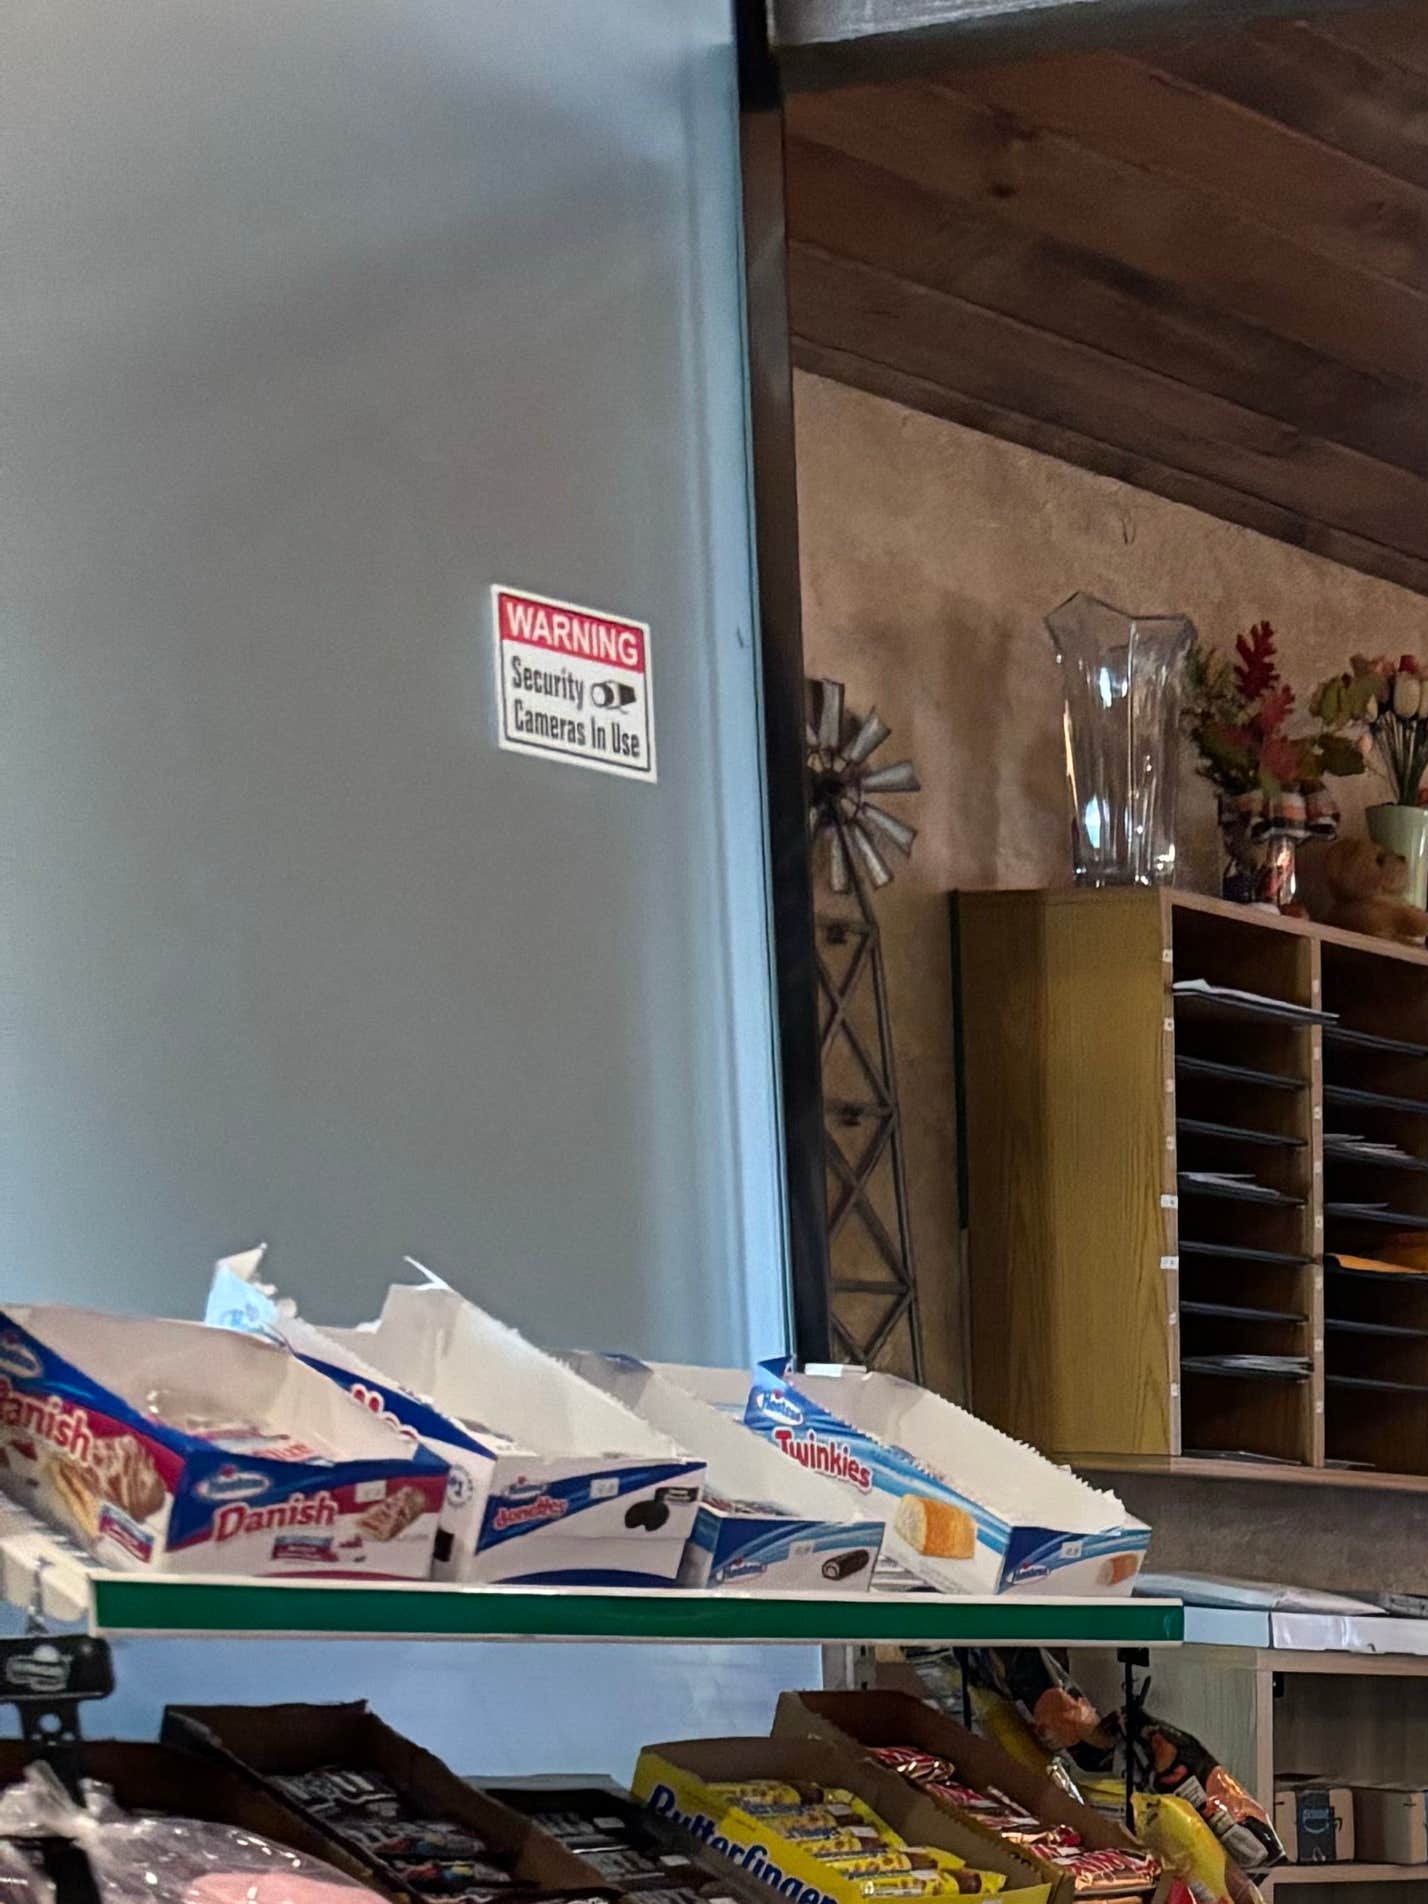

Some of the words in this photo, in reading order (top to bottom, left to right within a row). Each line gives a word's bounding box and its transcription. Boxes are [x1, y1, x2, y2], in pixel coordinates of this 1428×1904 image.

[506, 602, 638, 666] WARNING
[511, 655, 584, 710] Security
[514, 699, 585, 745] Cameras
[592, 717, 605, 750] In
[612, 723, 640, 757] Use
[0, 1377, 92, 1463] anish
[774, 1428, 872, 1490] Twinkies
[213, 1495, 337, 1543] Danish
